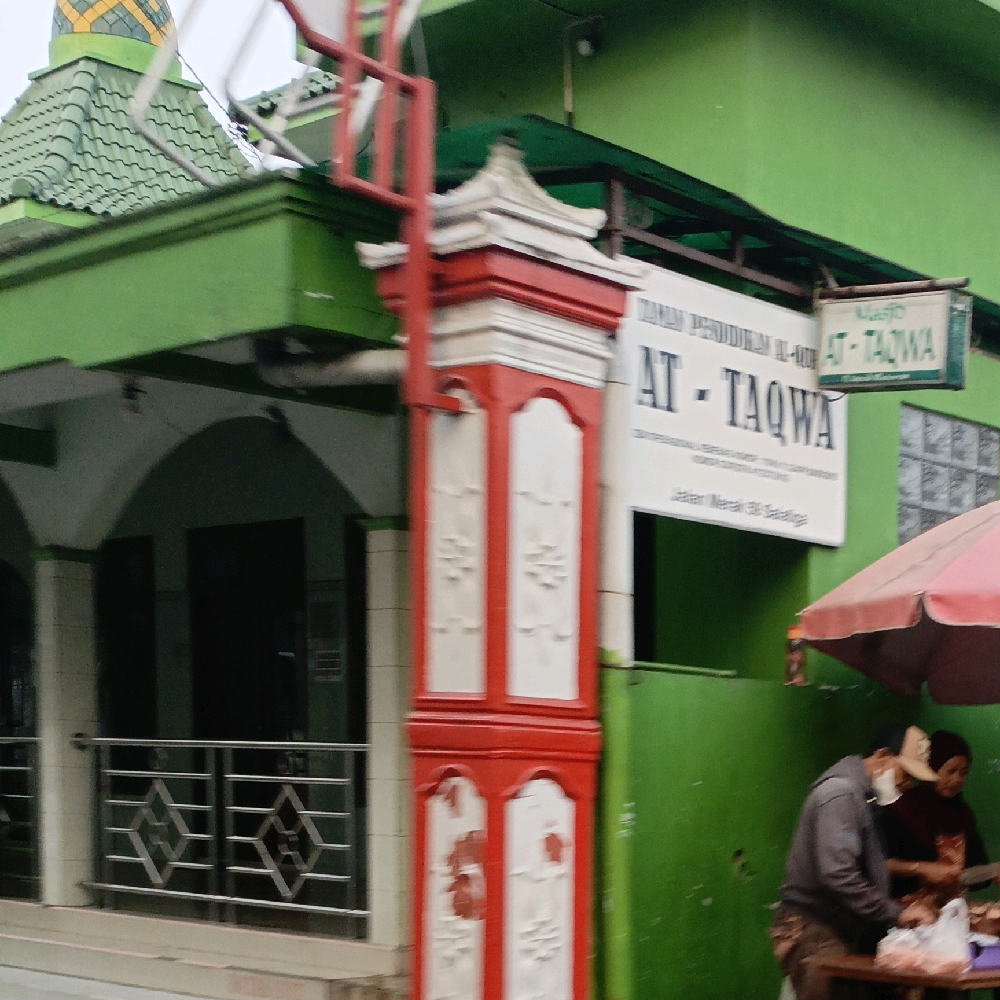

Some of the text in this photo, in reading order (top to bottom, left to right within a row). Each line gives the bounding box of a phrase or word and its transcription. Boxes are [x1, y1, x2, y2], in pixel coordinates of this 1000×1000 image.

[823, 331, 848, 366] AT
[863, 327, 936, 368] TAQWA
[636, 345, 681, 413] AT
[720, 366, 837, 450] TAQWA
